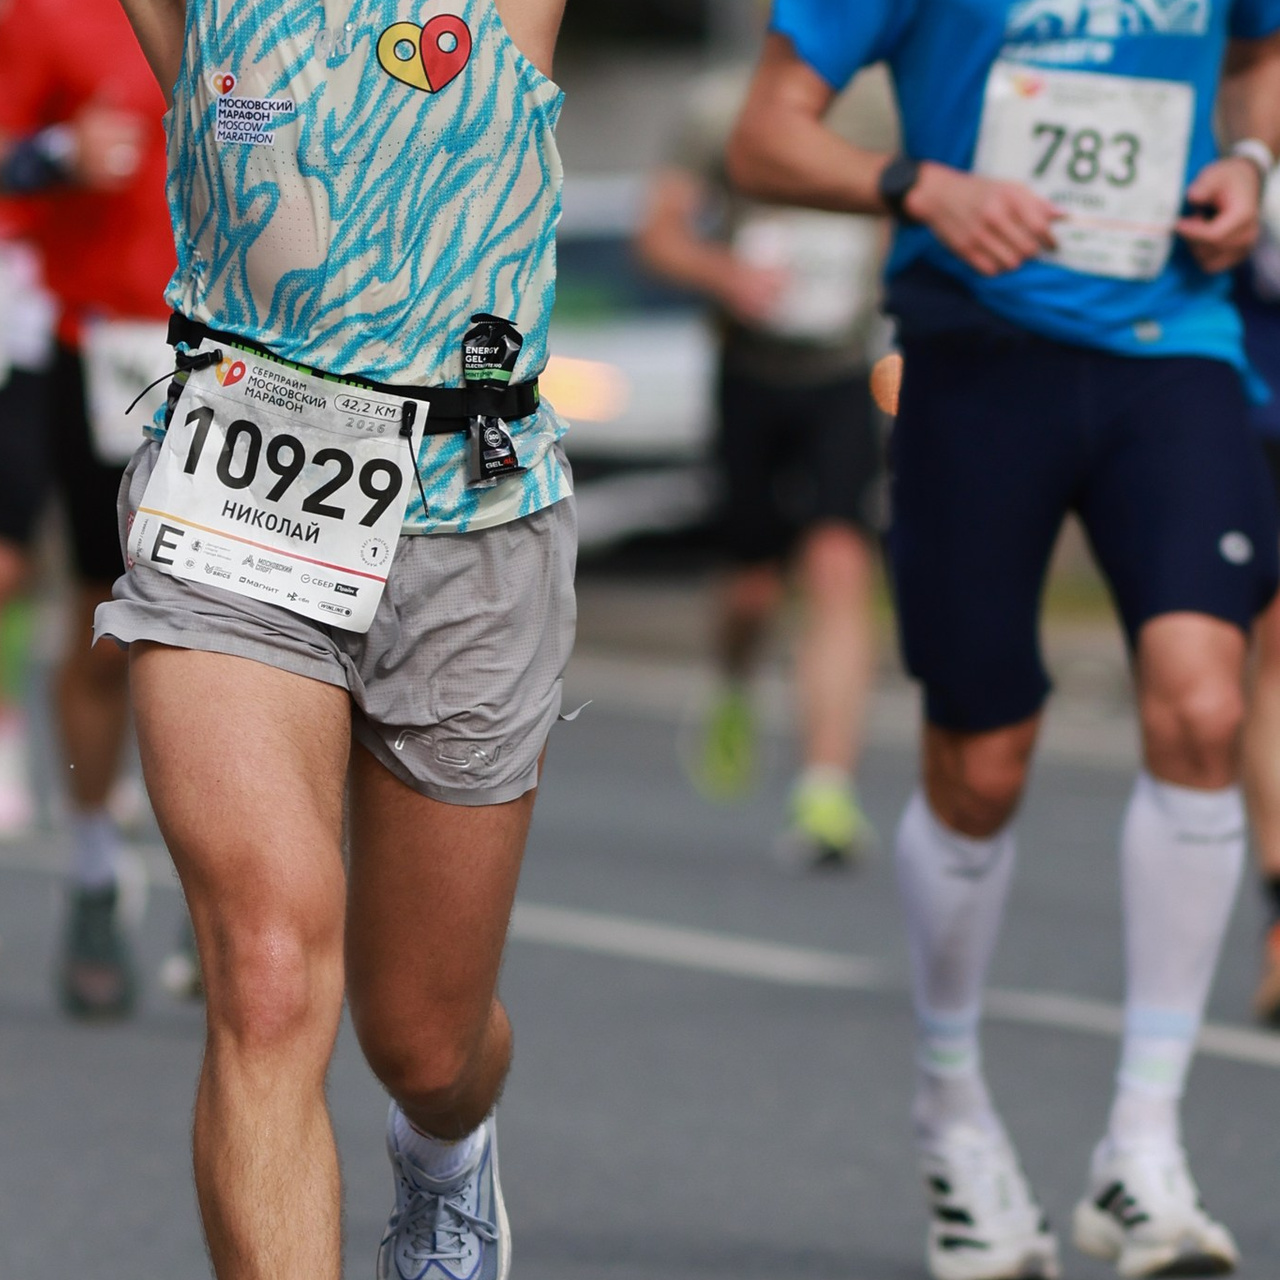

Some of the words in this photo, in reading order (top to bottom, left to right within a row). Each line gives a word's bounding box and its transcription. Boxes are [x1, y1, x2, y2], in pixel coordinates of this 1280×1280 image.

[218, 97, 293, 112] МОСКОВСКИЙ
[218, 109, 270, 121] МАРАФОН
[217, 120, 263, 132] MOSCOW
[217, 131, 273, 144] MARATHON
[1032, 122, 1142, 188] 783
[465, 346, 499, 354] ENERGY
[252, 366, 307, 391] СБЕРПРАЙМ
[244, 387, 303, 414] МАРАФОН
[247, 375, 327, 410] МОСКОВСКИЙ
[342, 399, 370, 415] 42,2
[374, 405, 397, 418] КМ
[345, 417, 386, 433] 2026
[183, 405, 403, 527] 10929
[221, 499, 320, 544] НИКОЛАЙ
[150, 523, 185, 565] E
[371, 546, 378, 558] 1
[311, 578, 334, 588] СБЕР
